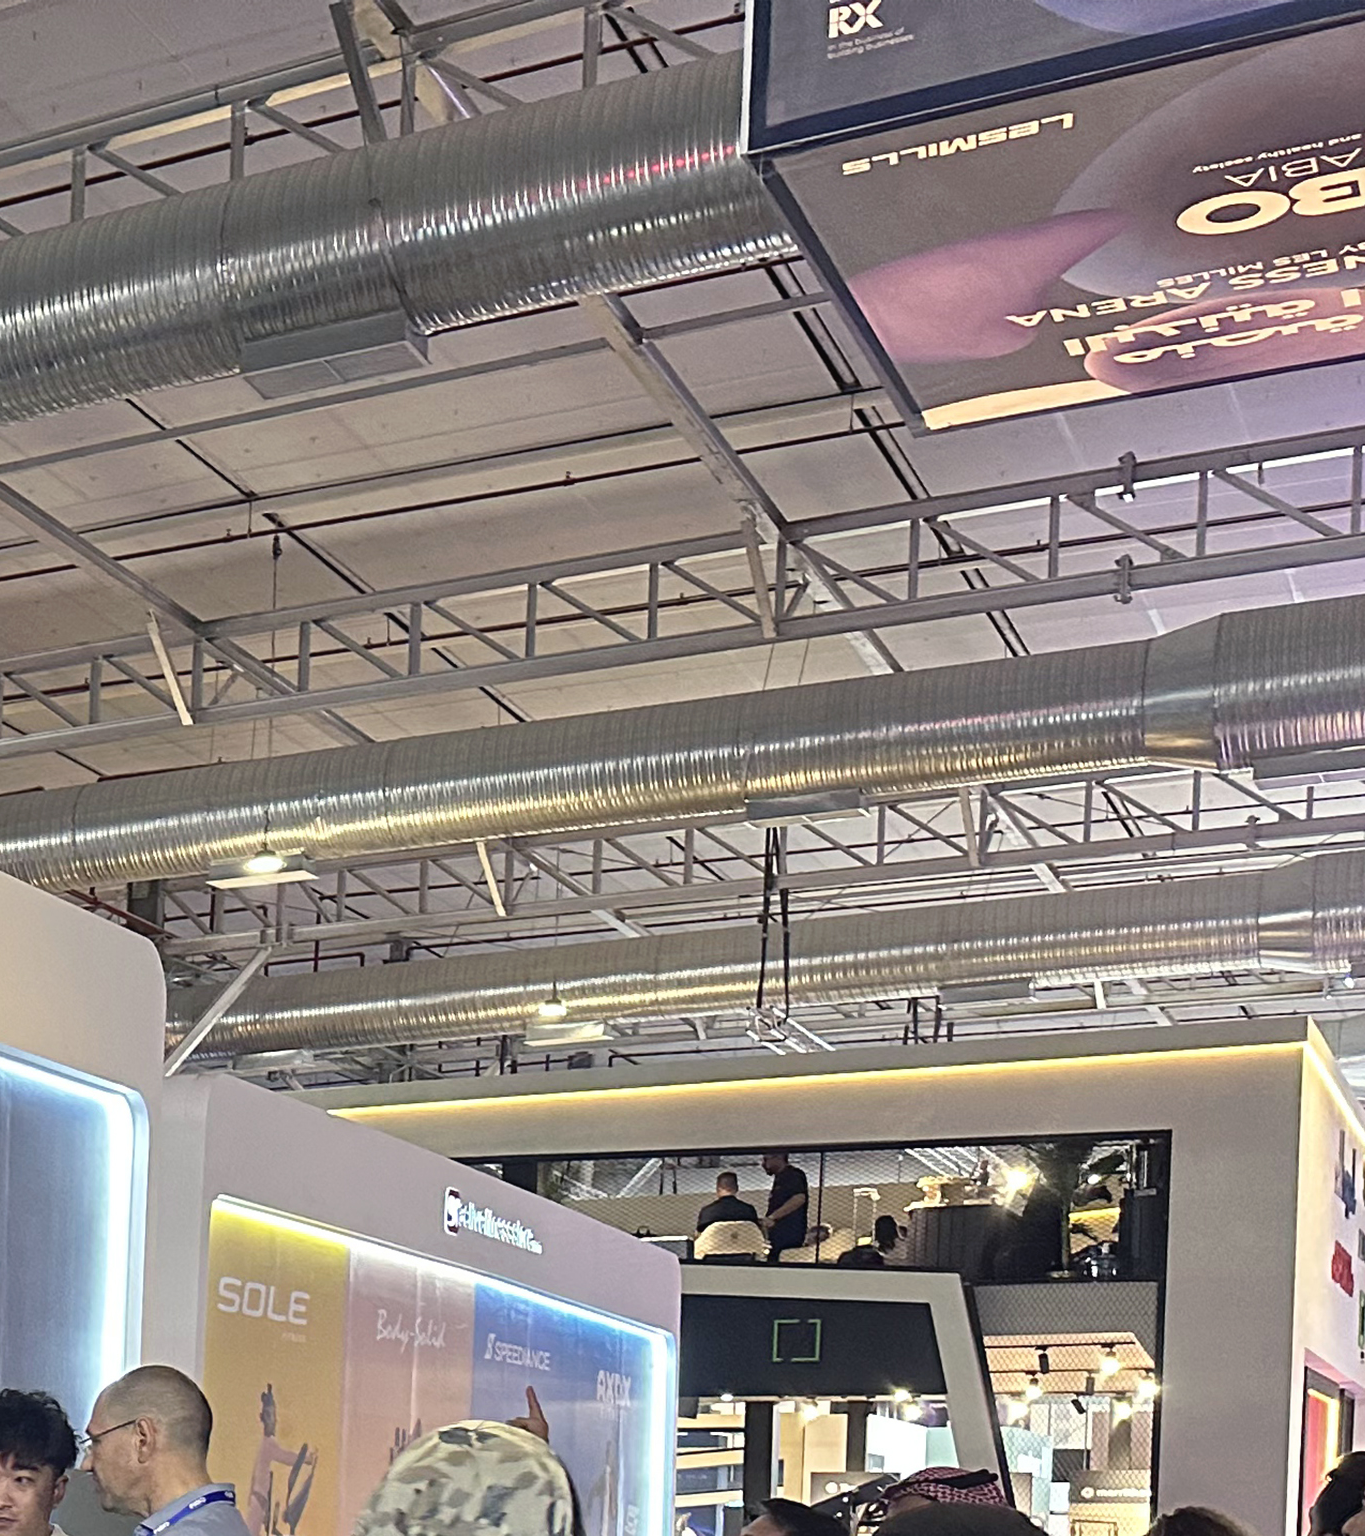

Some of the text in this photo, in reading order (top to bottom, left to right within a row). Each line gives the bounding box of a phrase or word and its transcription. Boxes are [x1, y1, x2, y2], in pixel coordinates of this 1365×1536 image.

[828, 0, 884, 38] RX
[1273, 249, 1328, 267] LES
[1005, 281, 1212, 328] ARENA
[217, 1276, 310, 1326] SOLE
